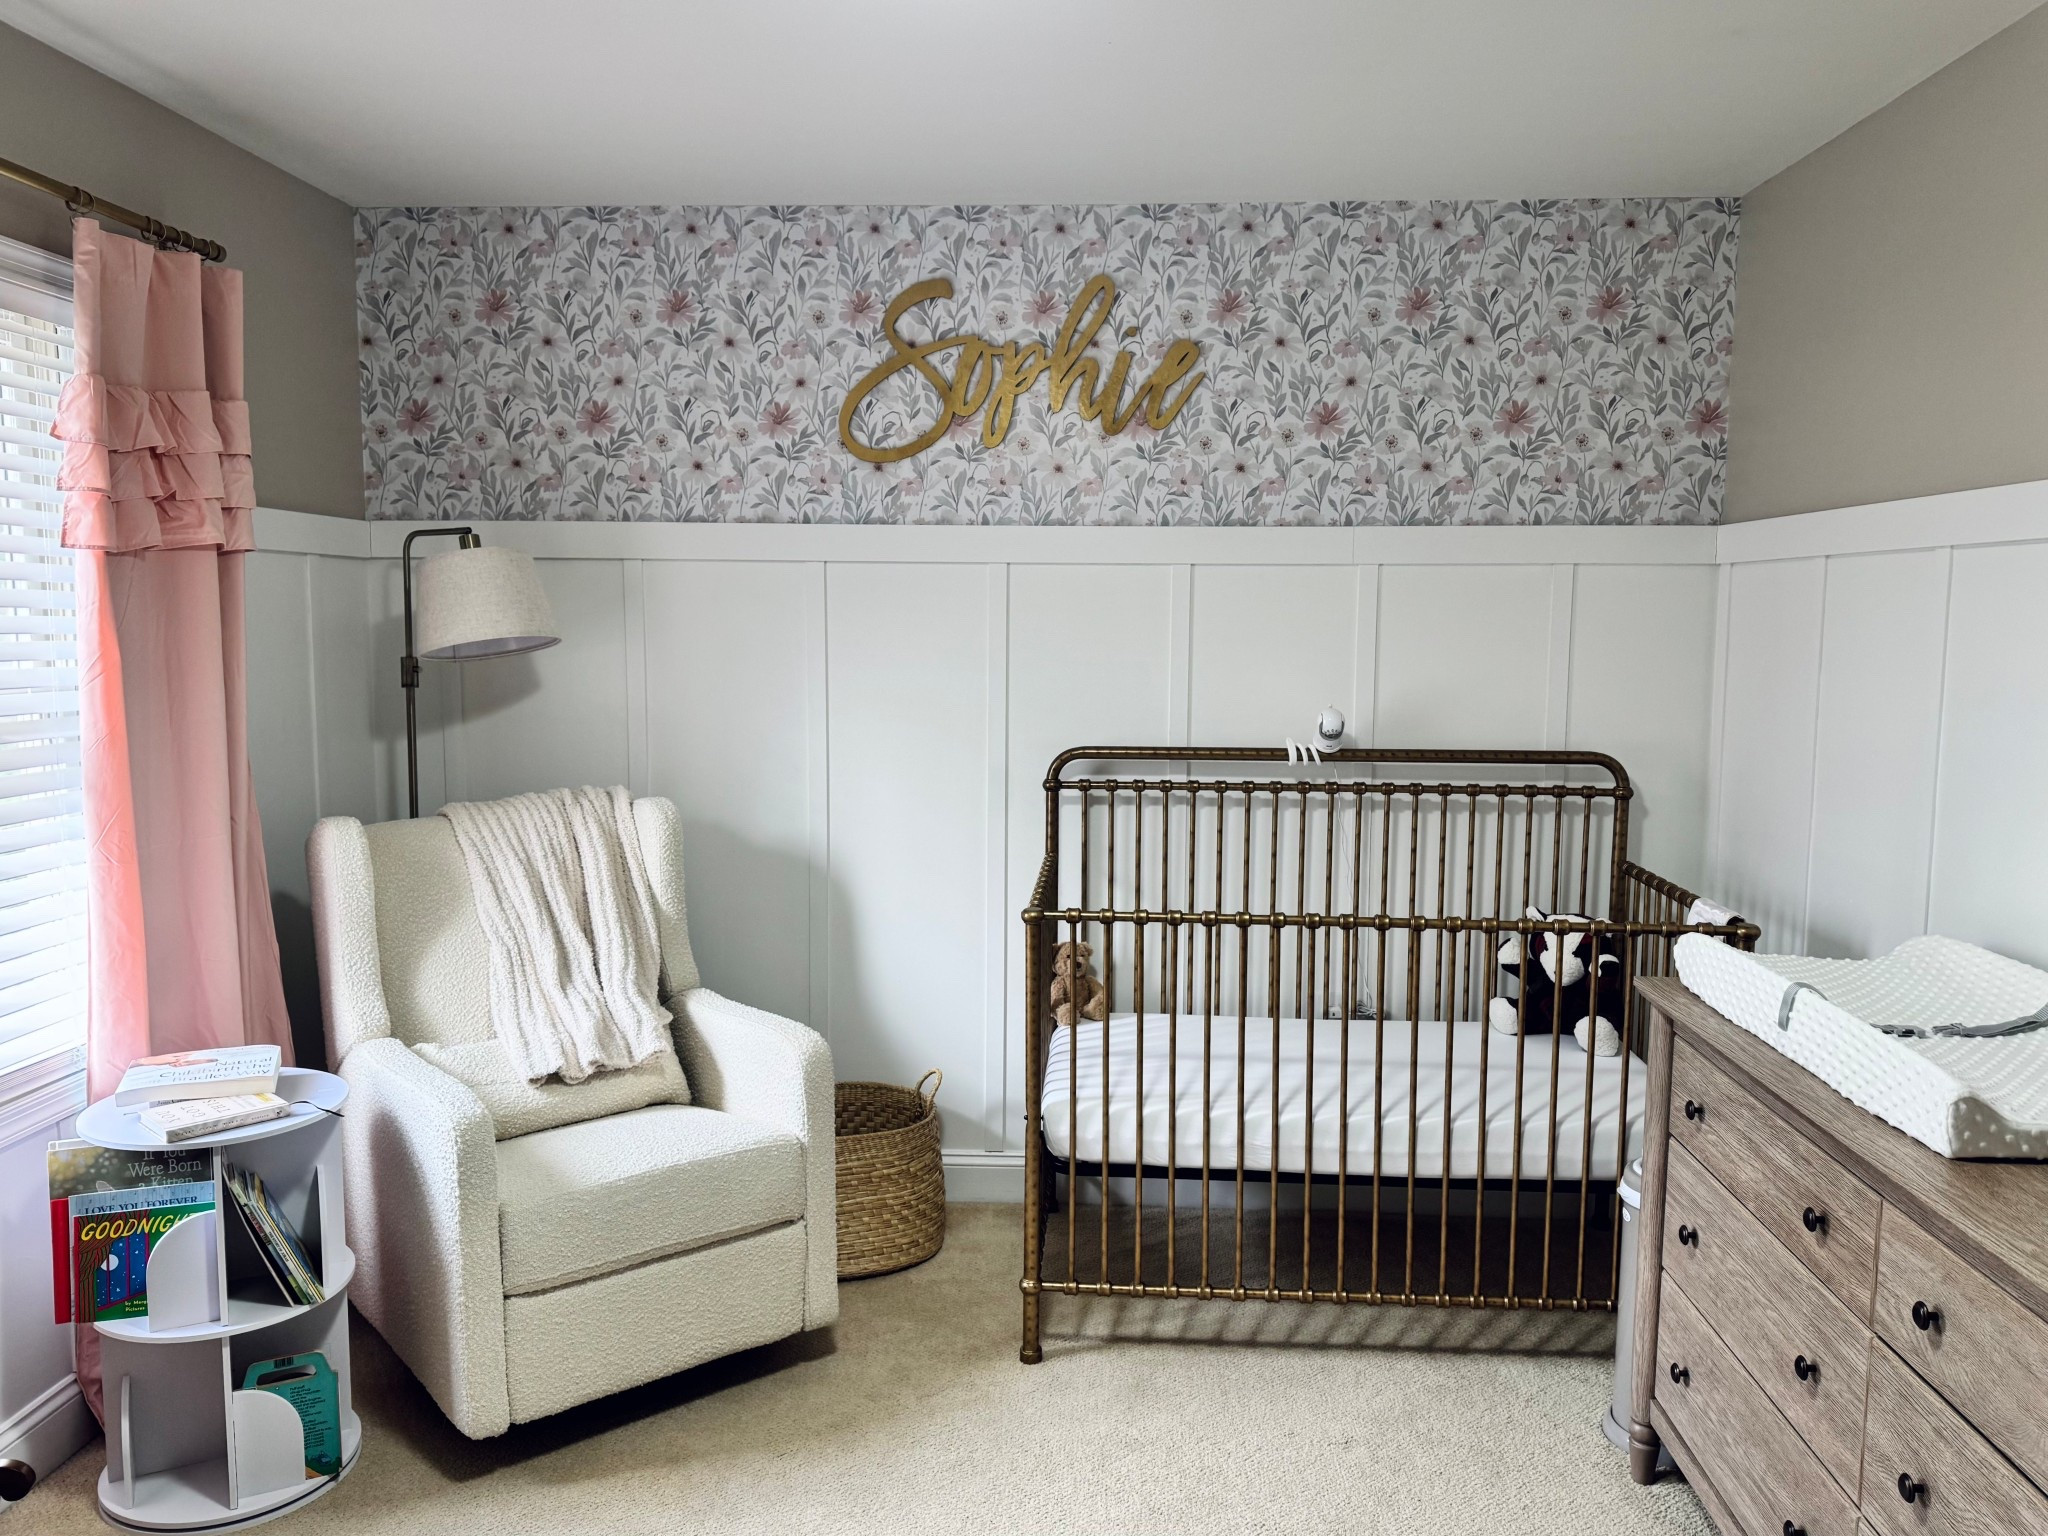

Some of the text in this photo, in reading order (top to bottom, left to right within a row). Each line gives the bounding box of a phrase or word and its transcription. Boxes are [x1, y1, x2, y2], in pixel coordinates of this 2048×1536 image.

[839, 274, 1206, 463] Sophie
[215, 1057, 272, 1067] Natural
[128, 1158, 202, 1178] Were Born
[85, 1196, 198, 1214] LOVE YOU FOREVER
[81, 1213, 198, 1241] GOODNIGH
